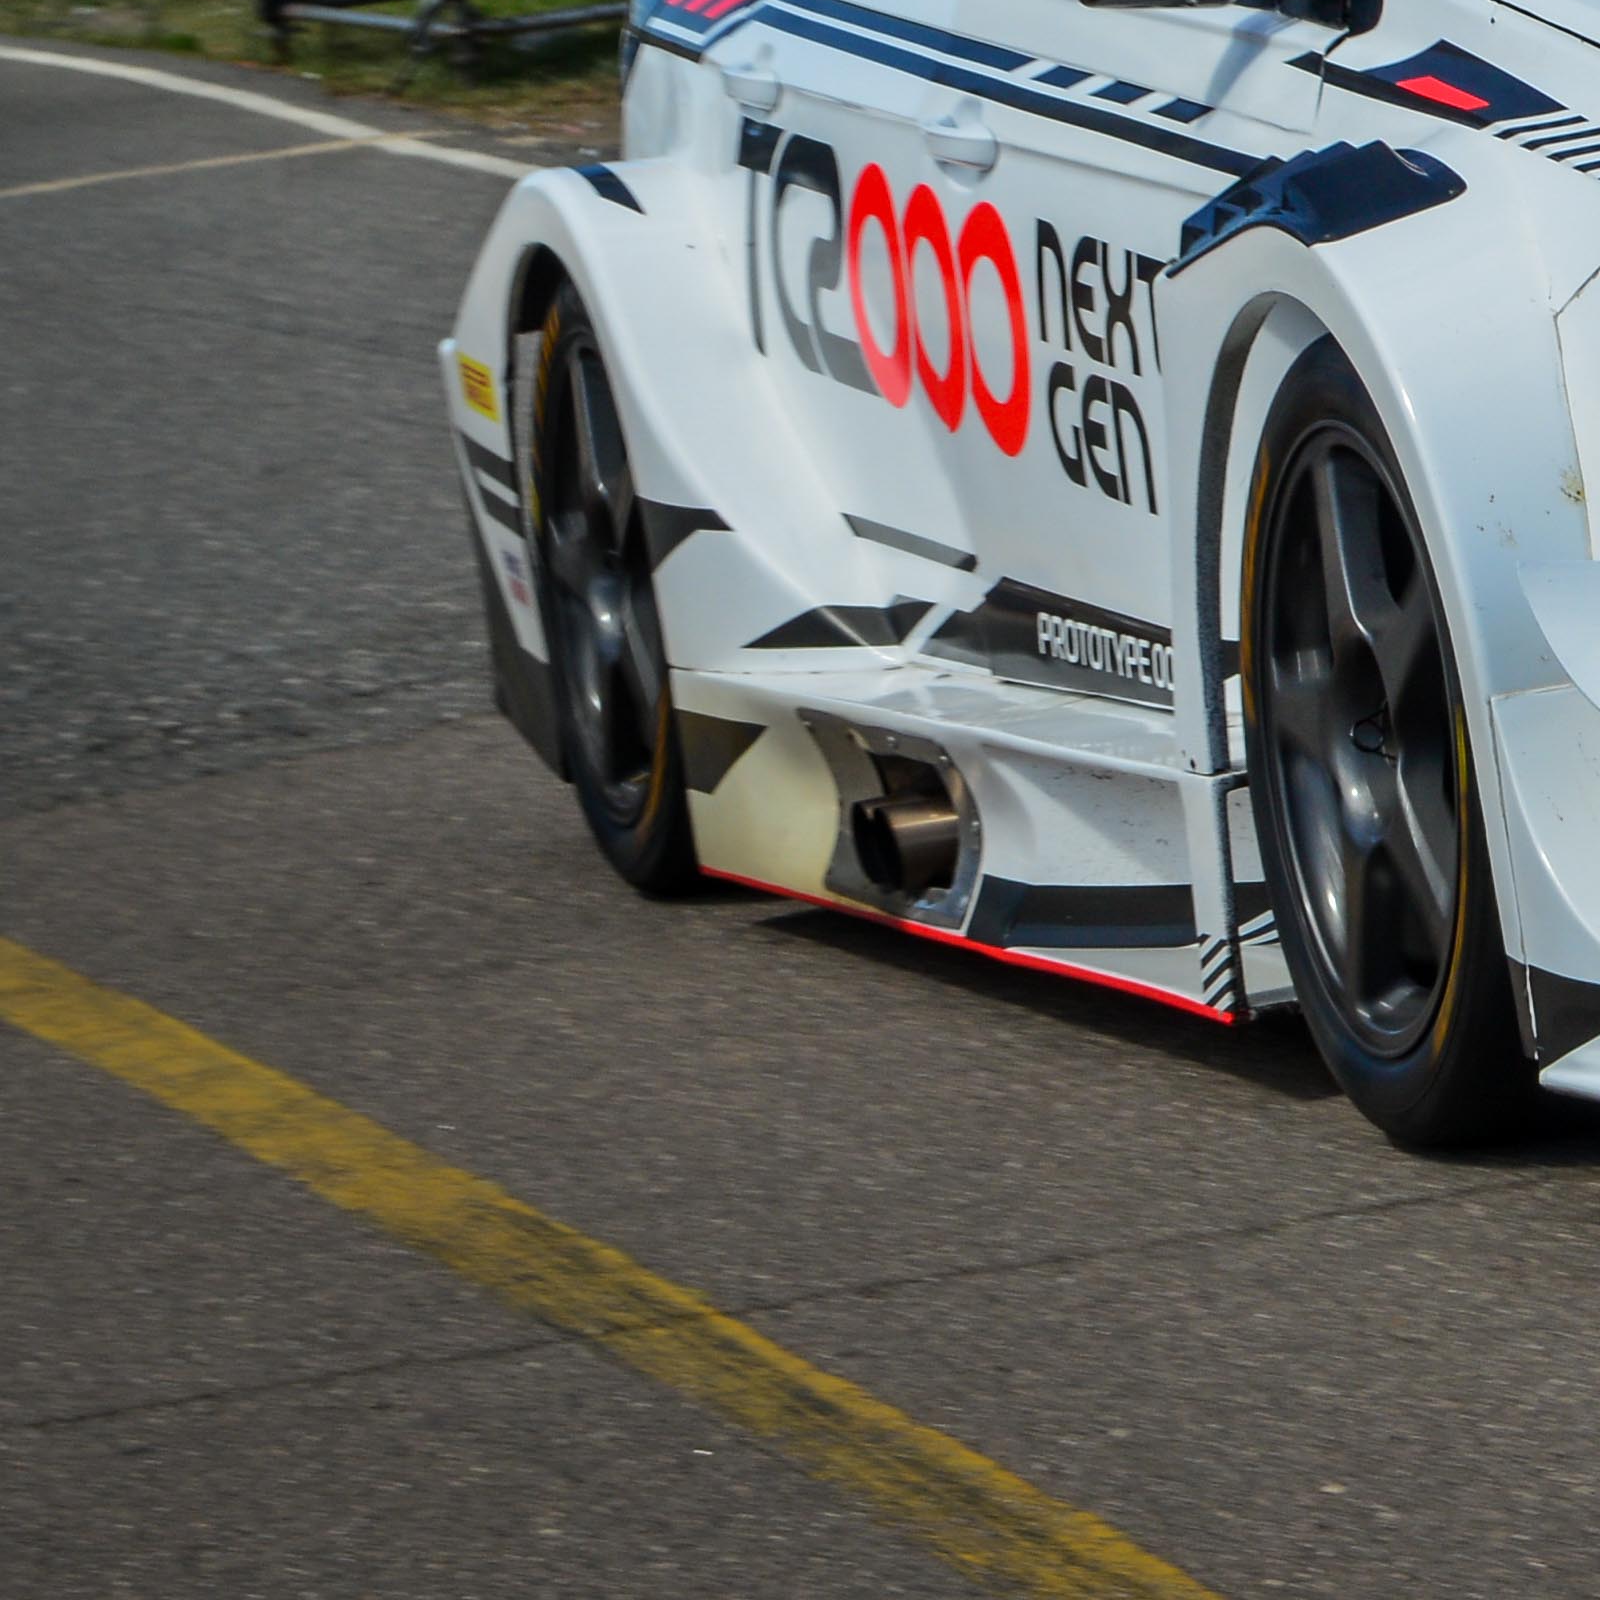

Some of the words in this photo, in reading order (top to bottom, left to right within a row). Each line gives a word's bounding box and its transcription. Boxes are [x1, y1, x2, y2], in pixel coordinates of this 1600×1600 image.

[1034, 217, 1169, 377] NEXT
[1047, 360, 1159, 516] GEN
[1037, 611, 1152, 685] PROTOTYPE
